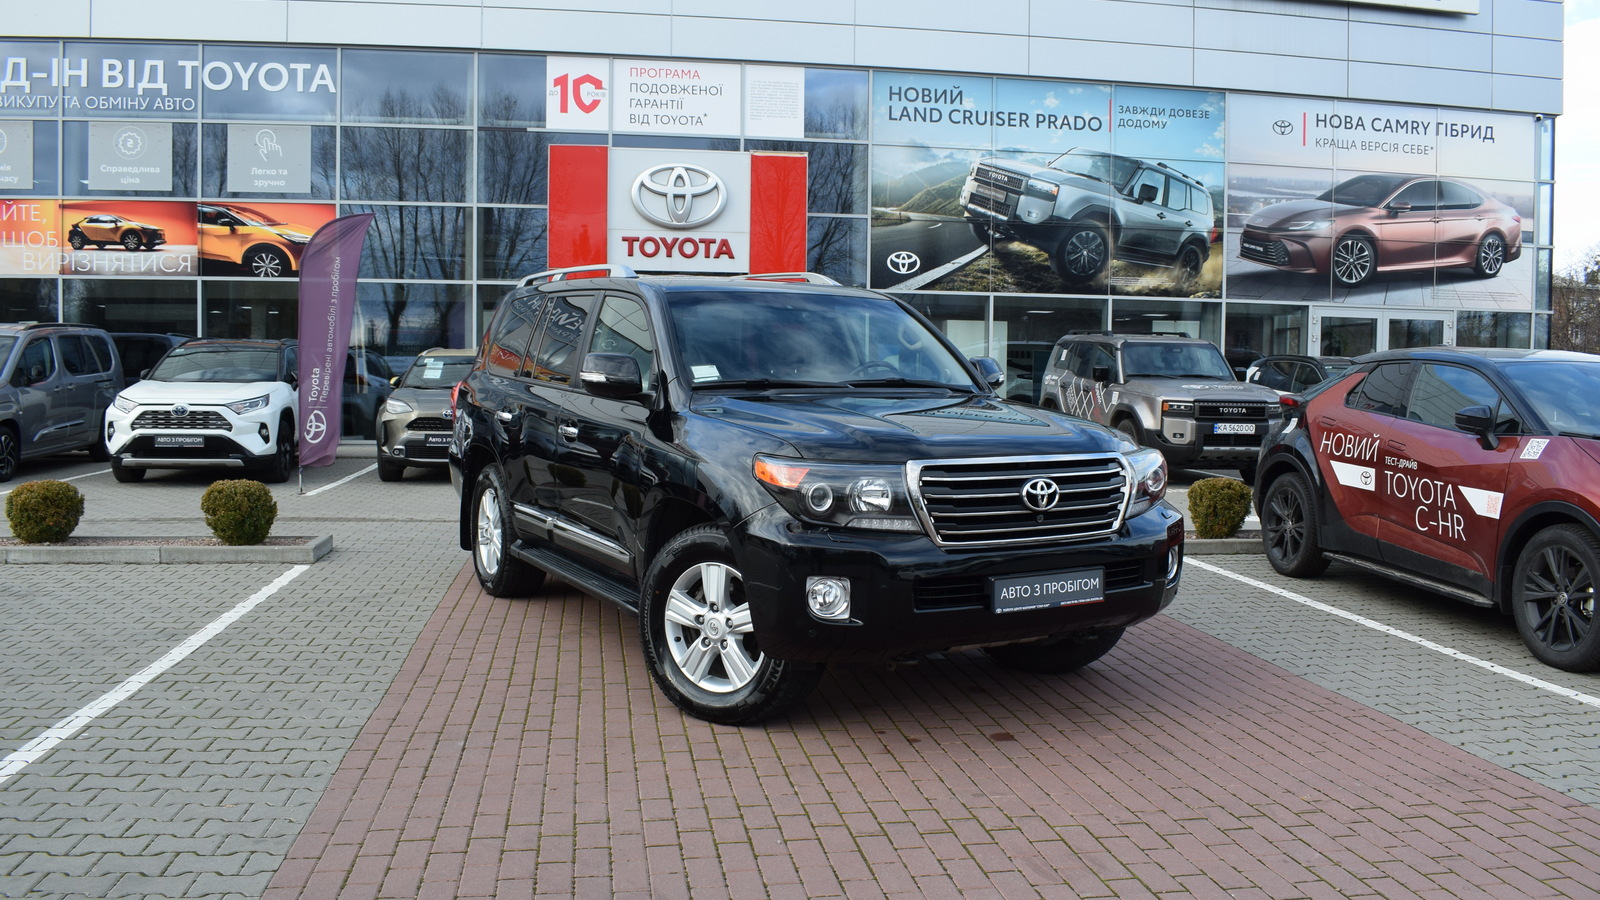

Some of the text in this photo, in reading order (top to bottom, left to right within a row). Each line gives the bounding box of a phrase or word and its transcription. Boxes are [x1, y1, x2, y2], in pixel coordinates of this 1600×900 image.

[102, 58, 168, 96] ВІД
[177, 60, 337, 93] TOYOTA
[629, 67, 701, 80] ПРОГРАМА
[629, 83, 724, 96] ПОДОВЖЕНОЇ
[888, 85, 963, 105] НОВИЙ
[63, 96, 81, 109] ТА
[85, 96, 150, 110] ОБМІНУ
[153, 97, 195, 111] АВТО
[629, 97, 685, 110] ГАРАНТІЇ
[1118, 105, 1210, 119] ЗАВЖДИ ДОВЕЗЕ
[629, 113, 651, 126] ВІД
[888, 105, 1103, 132] LAND CRUISER PRADO
[1118, 118, 1168, 129] ДОДОМУ
[1315, 113, 1495, 143] НОВА CAMRY ГІБРИД
[1315, 138, 1358, 151] КРАЩА
[1360, 141, 1399, 153] ВЕРСІЯ
[100, 164, 160, 174] Справедлива
[251, 167, 277, 175] Легко
[120, 176, 140, 184] ціна
[253, 179, 286, 187] зручно
[0, 201, 47, 224] ЙТЕ,
[2, 230, 59, 251] ЩОБ
[621, 236, 736, 260] TOYOTA
[23, 252, 191, 273] ВИРІЗНЯТИСЯ
[330, 256, 341, 297] пробігом
[327, 305, 337, 352] автомобілі
[308, 367, 320, 402] Toyota
[319, 354, 332, 402] Перевірені
[1319, 431, 1380, 462] НОВИЙ
[1385, 456, 1418, 470] ТЕСТ-ДРАЙВ
[1384, 471, 1457, 510] TOYOTA
[1415, 506, 1466, 541] C-HR
[1000, 577, 1100, 600] АВТО З ПРОБІГОМ
